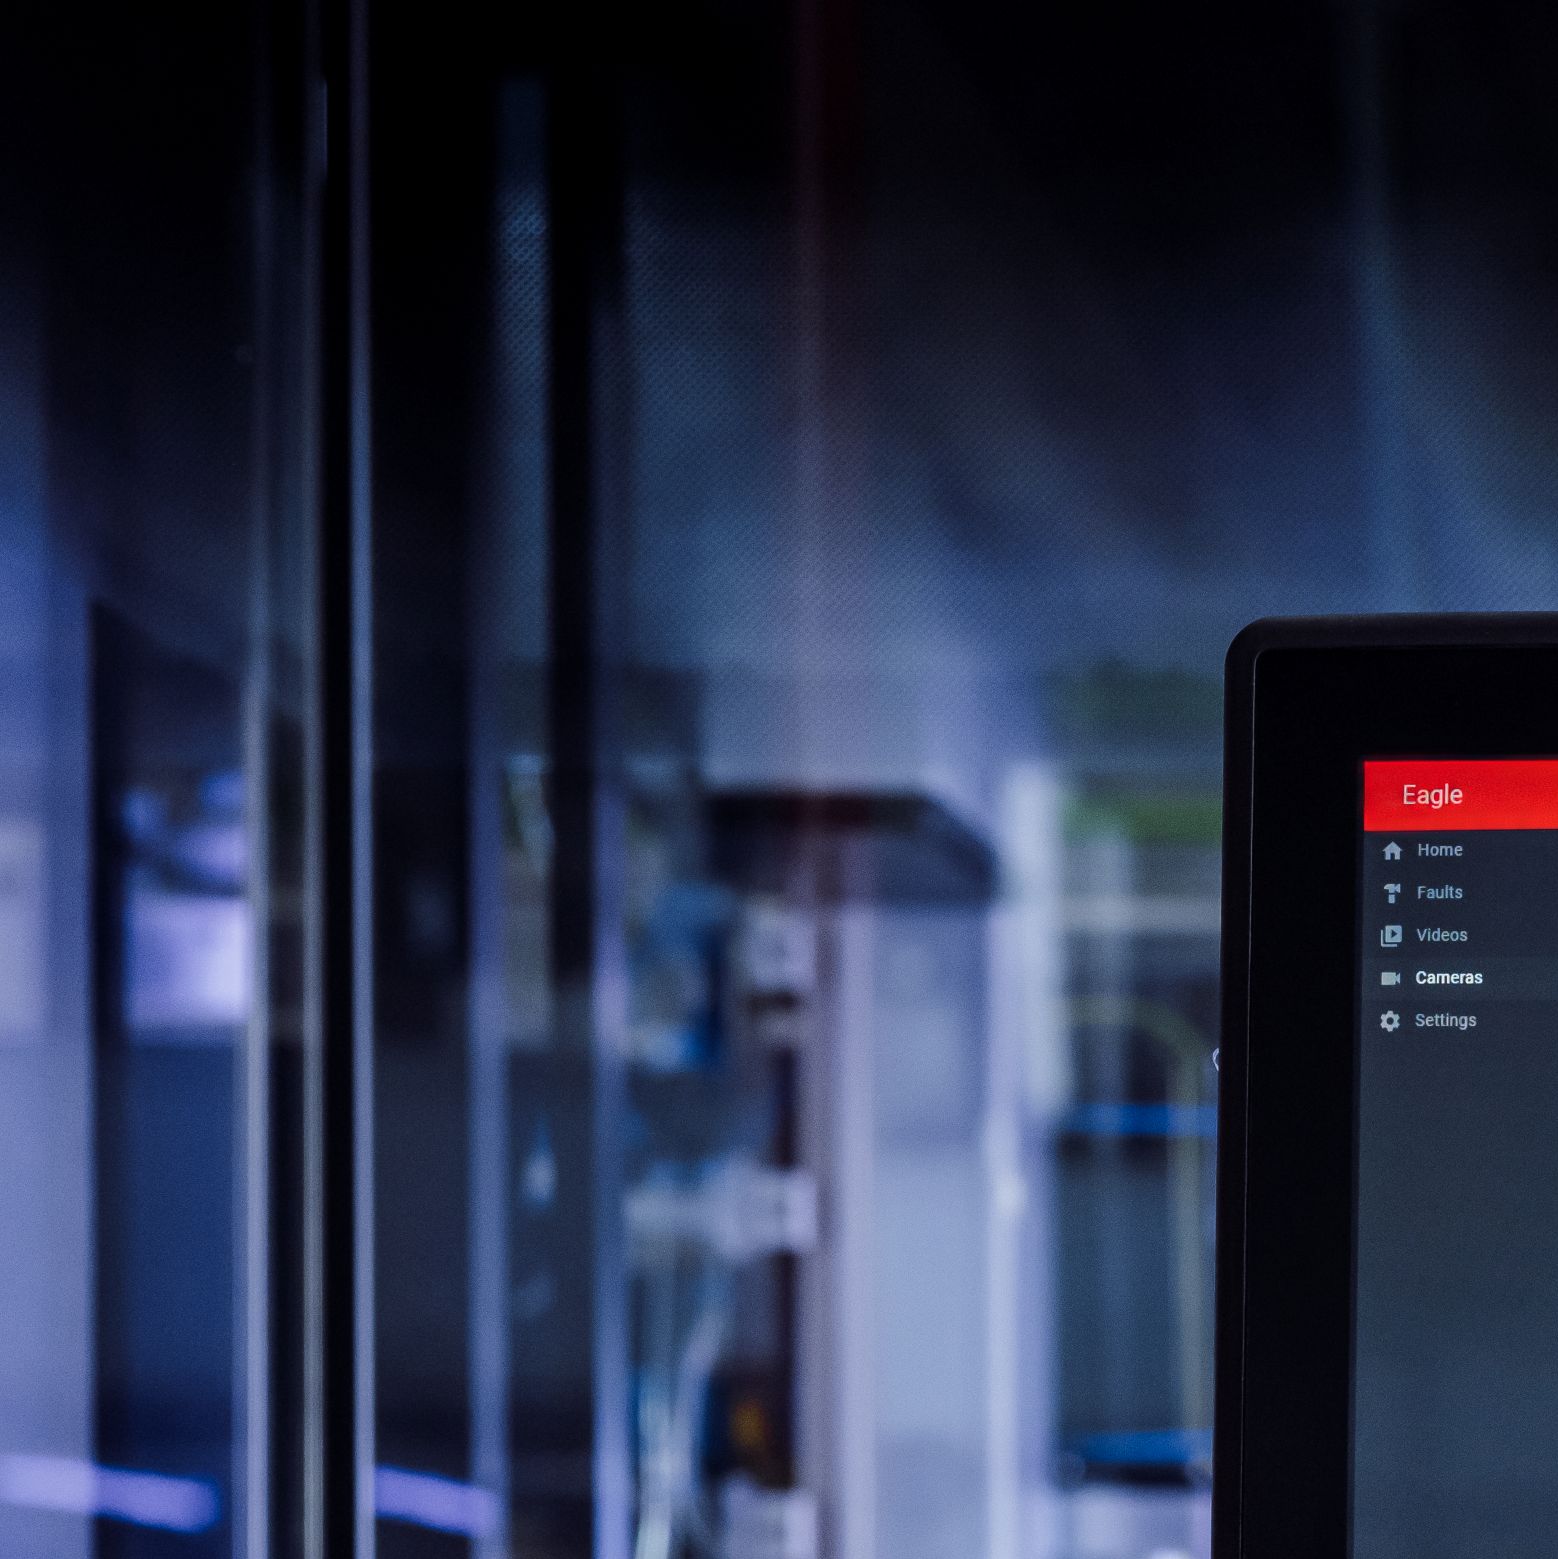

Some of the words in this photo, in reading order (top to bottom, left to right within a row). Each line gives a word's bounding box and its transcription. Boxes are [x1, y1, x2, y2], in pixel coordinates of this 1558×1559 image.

[1403, 783, 1463, 809] Eagle
[1417, 842, 1463, 857] Home
[1417, 884, 1463, 899] Faults
[1416, 927, 1468, 942] Videos
[1415, 970, 1483, 985] Cameras
[1415, 1012, 1477, 1031] Settings
